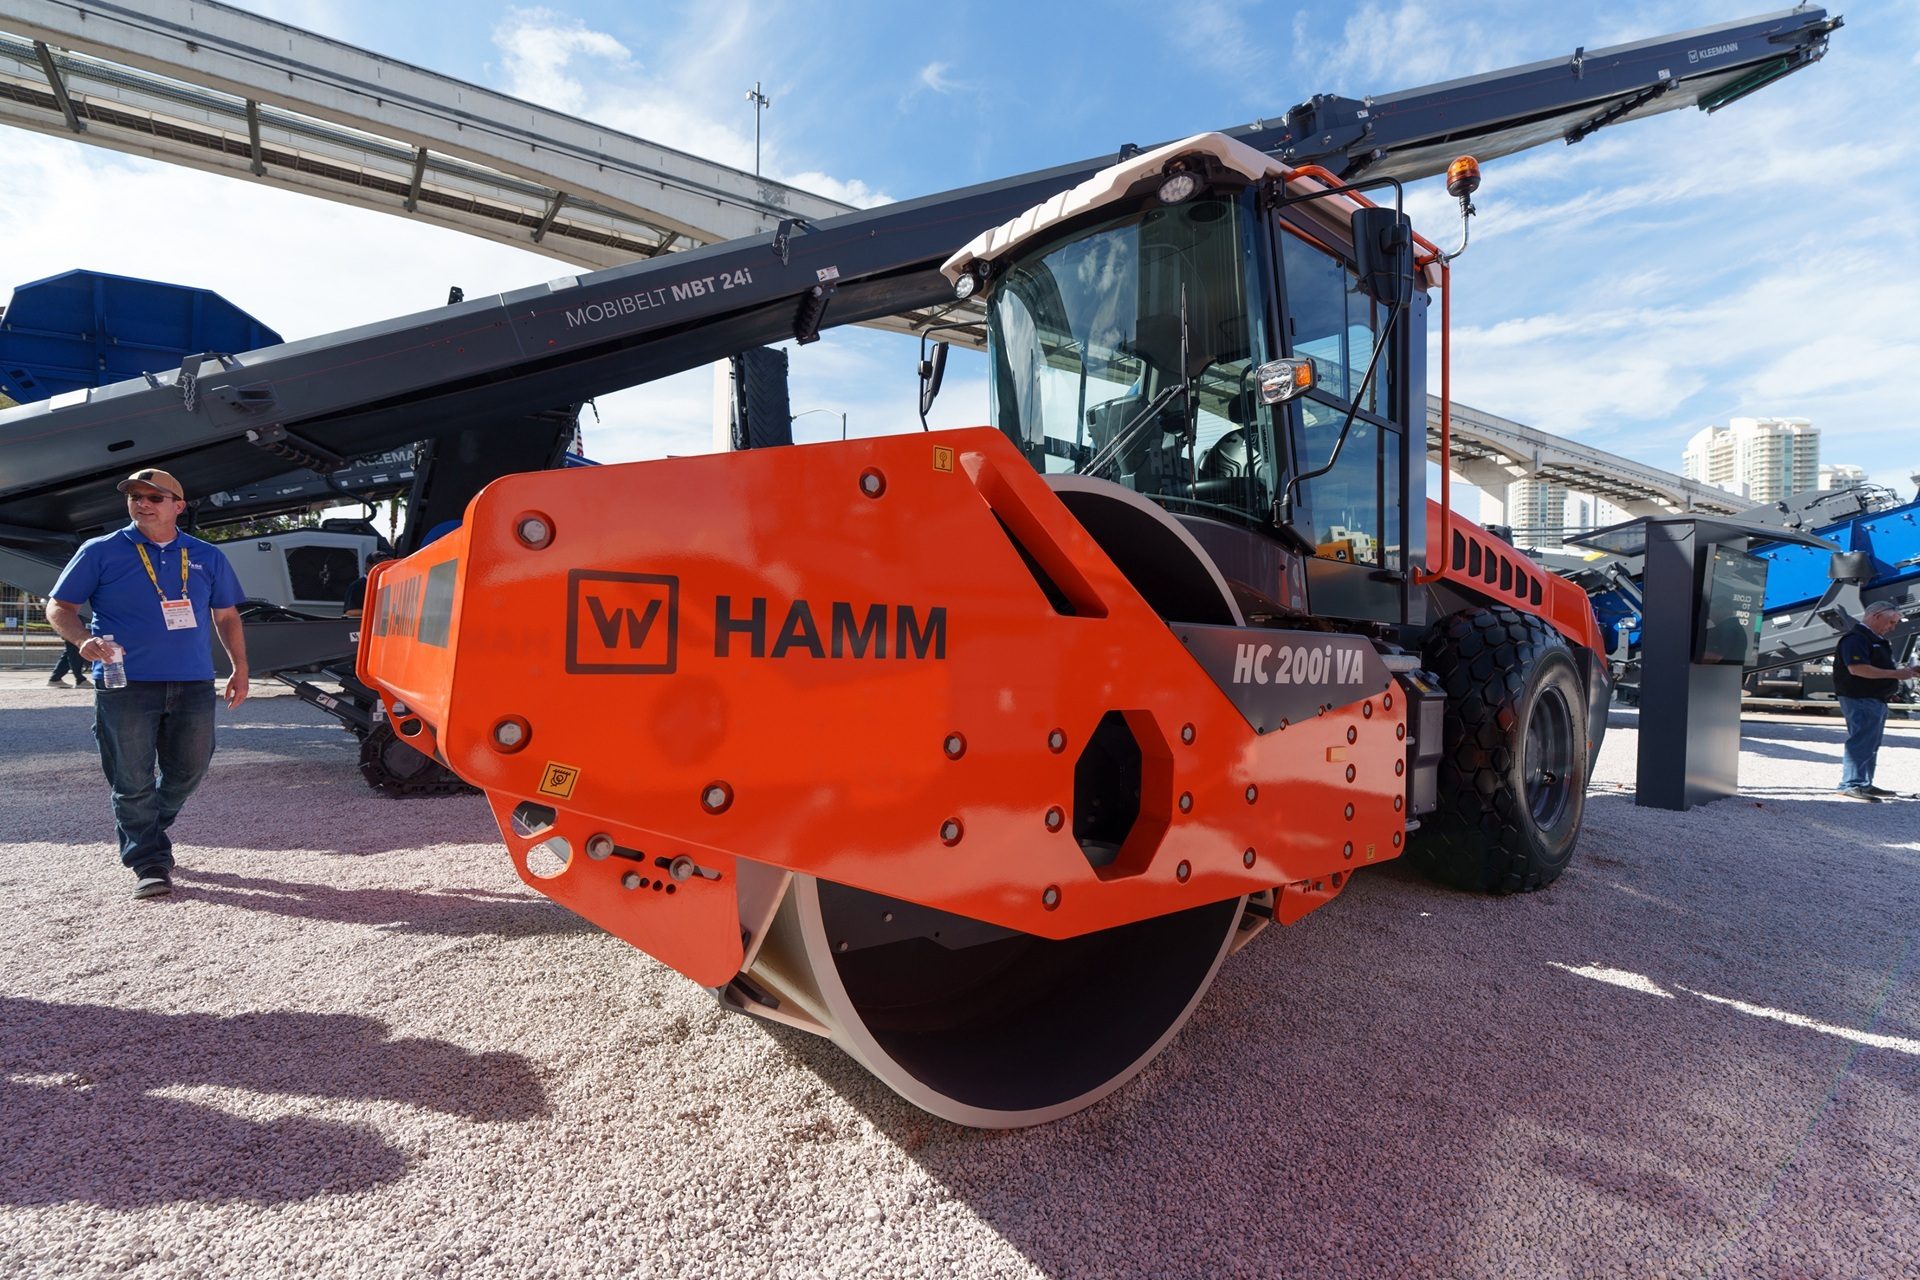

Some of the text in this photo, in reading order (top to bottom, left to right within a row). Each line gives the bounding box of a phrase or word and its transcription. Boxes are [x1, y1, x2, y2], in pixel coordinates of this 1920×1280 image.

[1699, 42, 1738, 59] KLEEMANN
[565, 267, 753, 328] MOBIBELT MBT 24i
[714, 595, 948, 660] HAMM
[1232, 643, 1364, 685] HC 200i VA
